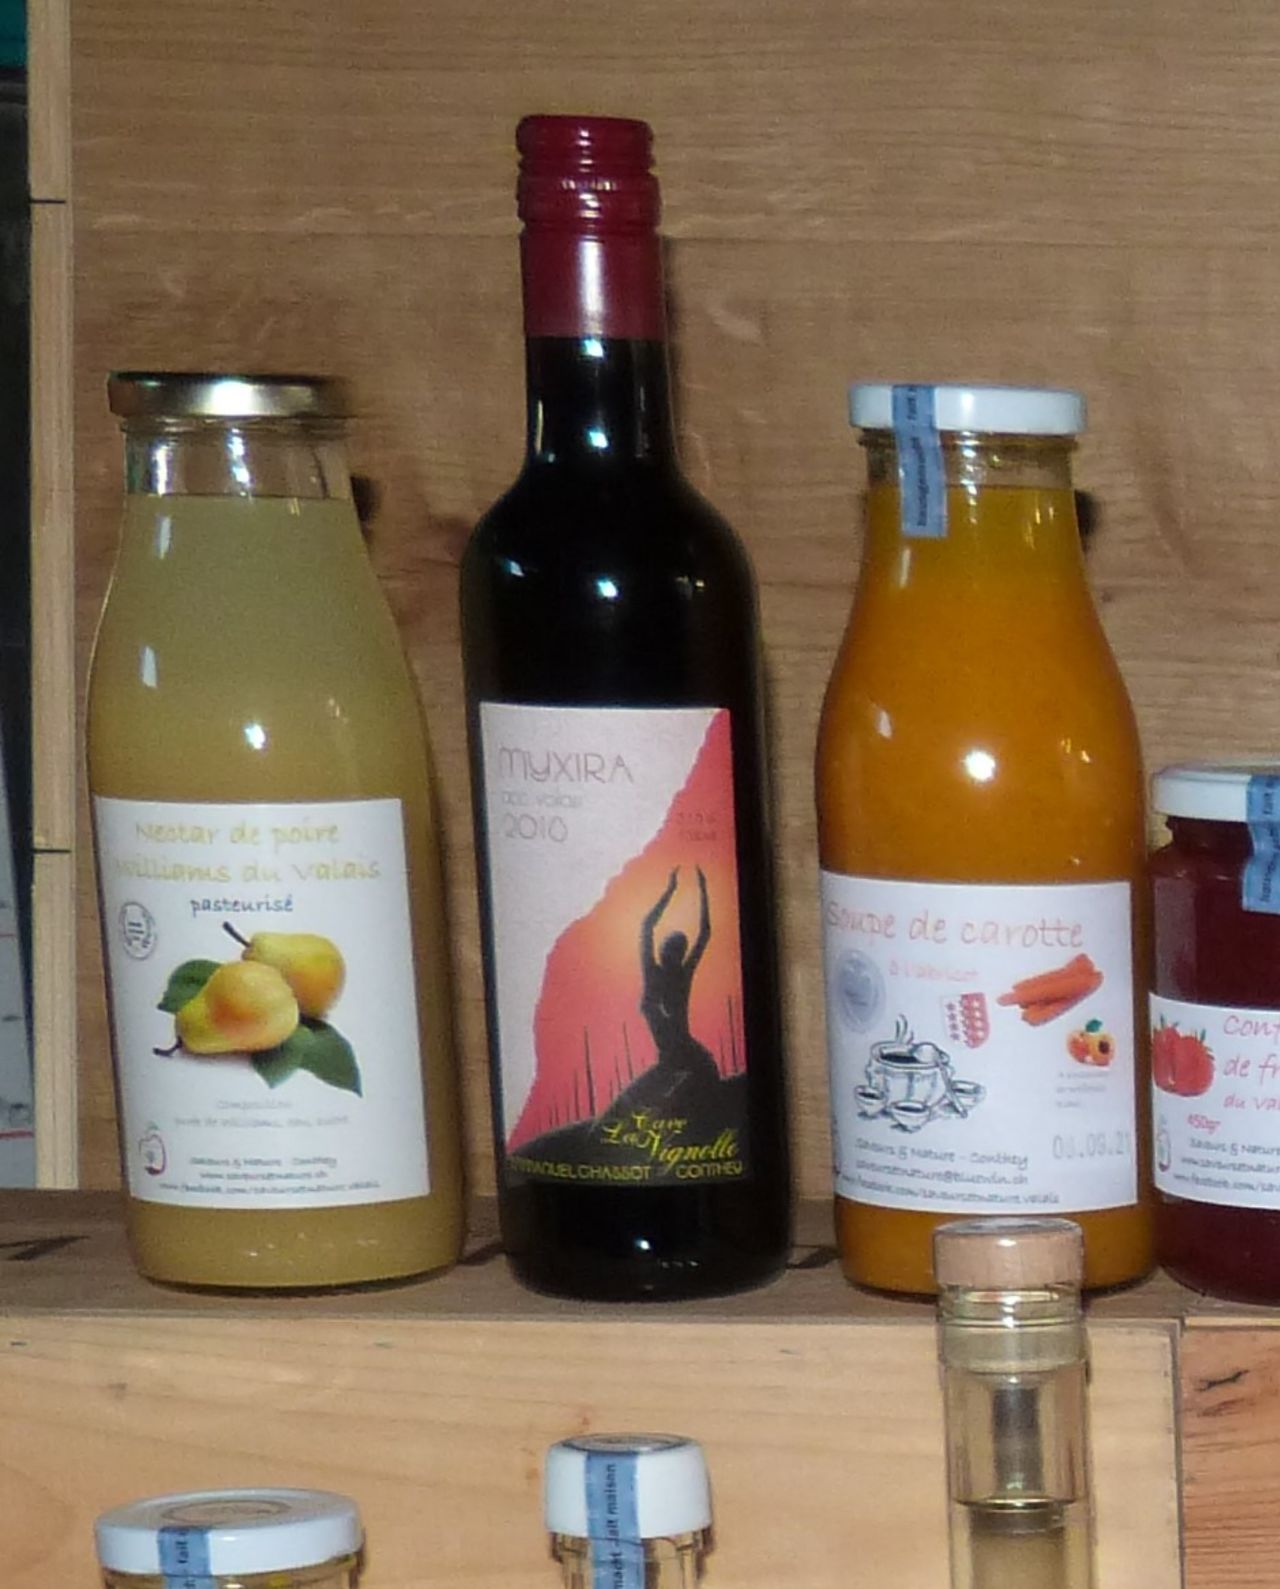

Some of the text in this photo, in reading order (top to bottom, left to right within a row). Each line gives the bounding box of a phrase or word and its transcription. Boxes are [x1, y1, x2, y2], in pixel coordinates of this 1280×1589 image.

[500, 747, 633, 783] MYXIRA
[136, 817, 338, 853] Nectar de poire
[505, 813, 568, 842] 2010
[241, 860, 282, 883] du
[190, 895, 293, 918] pasteurisé
[826, 902, 1083, 947] Soupe de carotte
[1223, 1055, 1250, 1078] de
[1224, 1094, 1249, 1110] du
